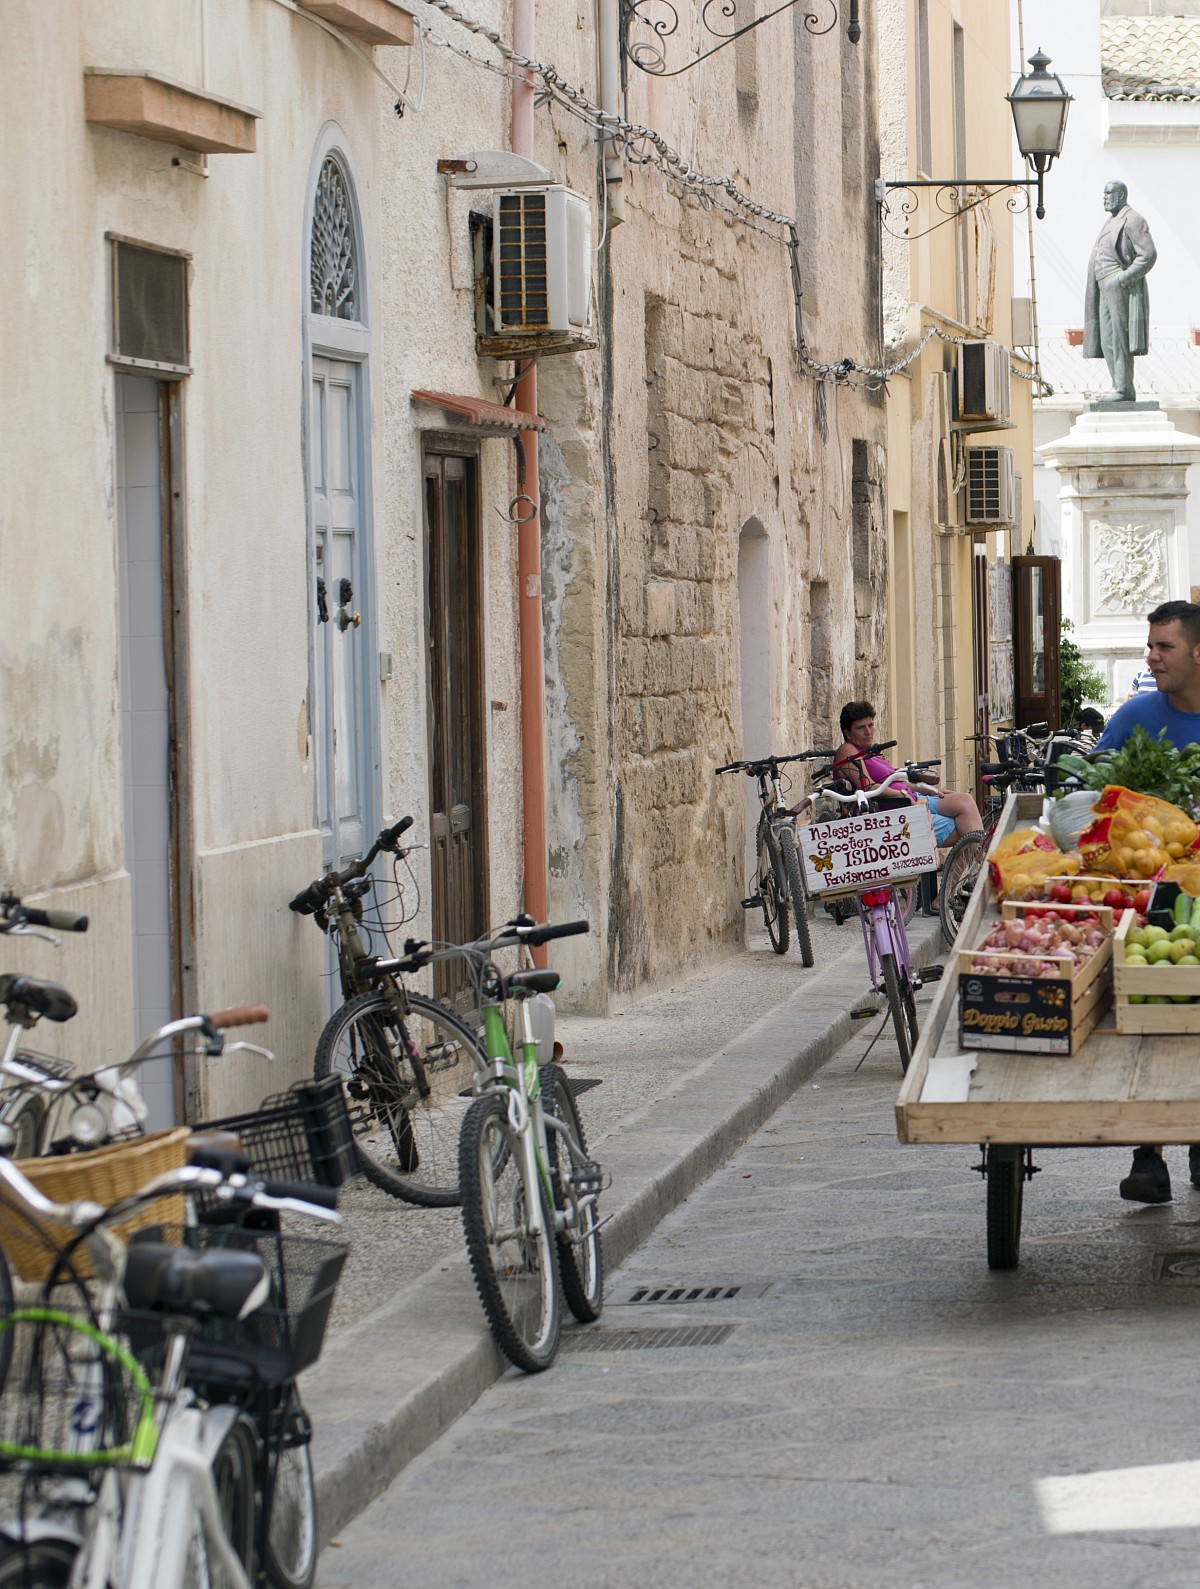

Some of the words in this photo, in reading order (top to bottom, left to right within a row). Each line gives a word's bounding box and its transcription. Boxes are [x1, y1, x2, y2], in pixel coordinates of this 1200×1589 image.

[863, 816, 892, 831] Bici
[817, 836, 874, 856] Scooter
[882, 831, 904, 843] da
[844, 841, 910, 868] ISIDORO
[823, 866, 891, 887] Favignana
[963, 1008, 1019, 1034] Doppio
[1021, 1012, 1068, 1035] Gusto
